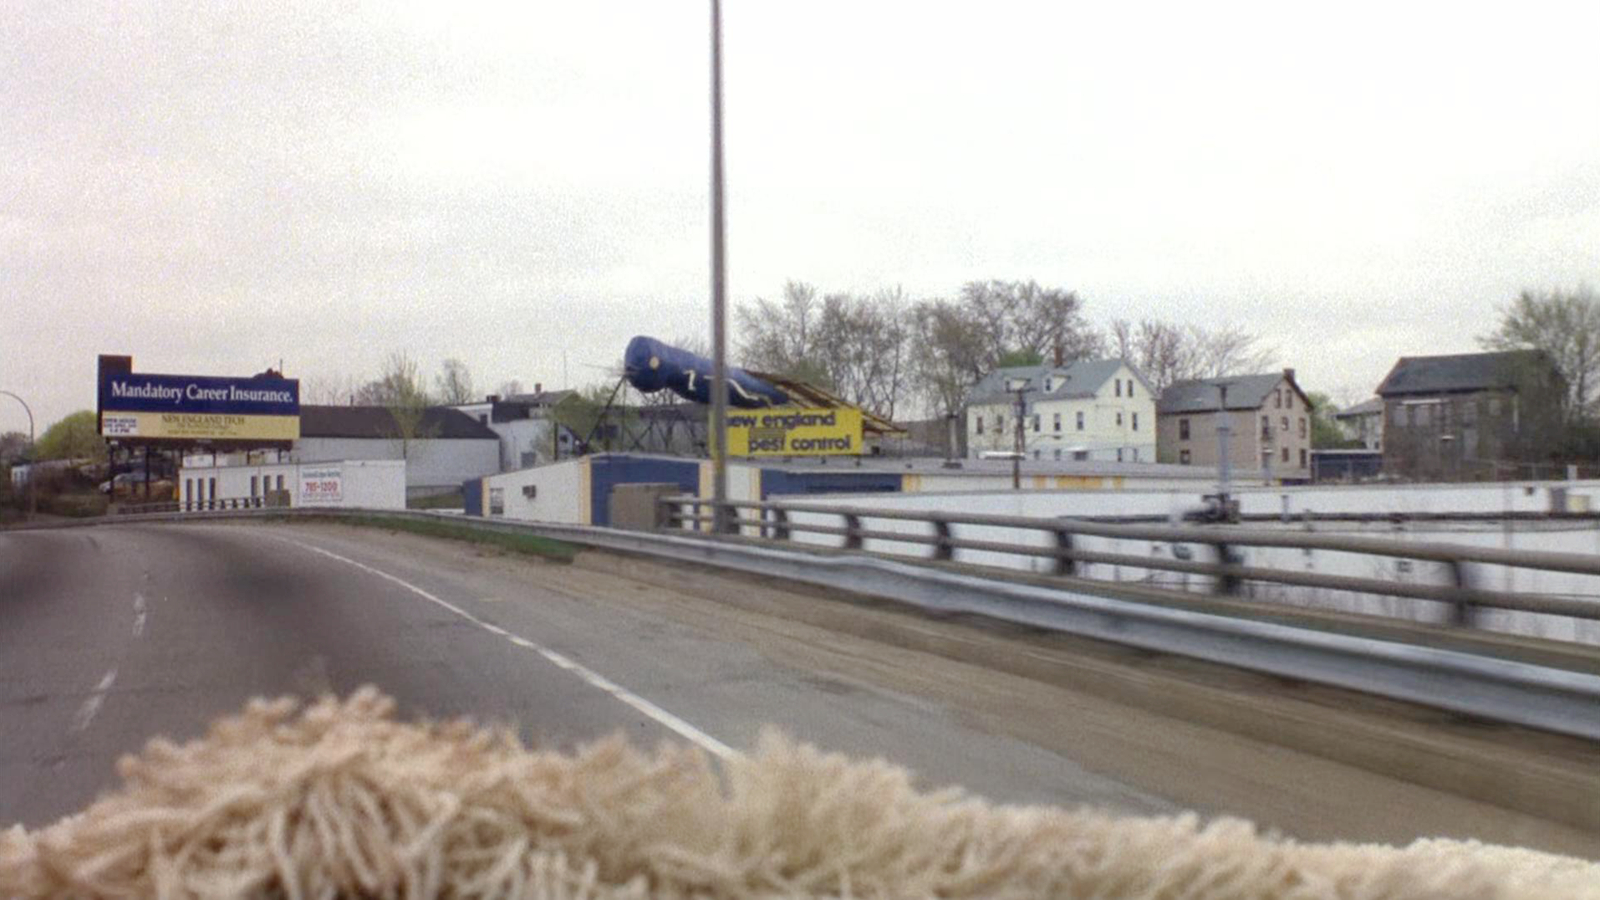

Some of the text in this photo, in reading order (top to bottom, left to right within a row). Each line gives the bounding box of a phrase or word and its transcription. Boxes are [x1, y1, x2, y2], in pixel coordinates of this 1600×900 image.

[111, 381, 293, 403] Mandatory Career Insurance.
[182, 415, 222, 424] ENGLAND
[762, 411, 836, 430] england
[749, 434, 851, 453] pest control
